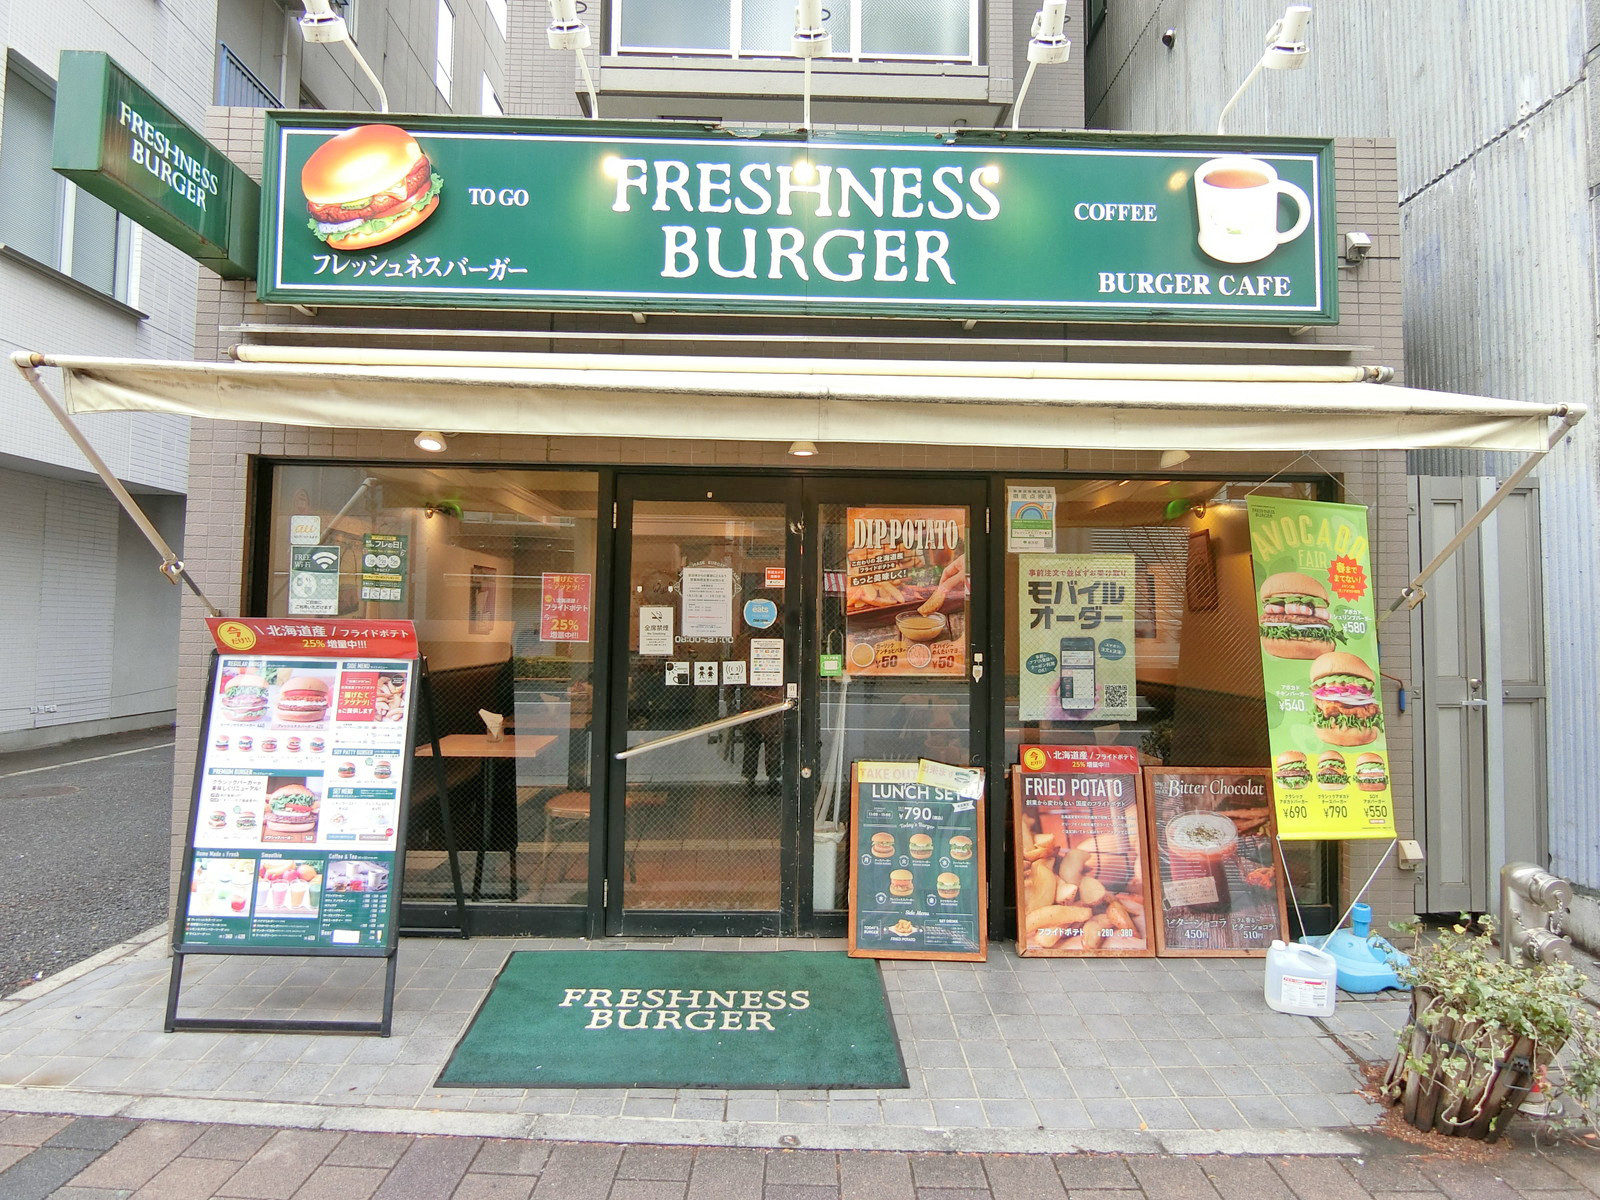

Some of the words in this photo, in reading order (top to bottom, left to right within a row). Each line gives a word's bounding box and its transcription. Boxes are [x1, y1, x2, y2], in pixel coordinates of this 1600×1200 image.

[119, 101, 219, 197] FRESHNESS
[131, 138, 208, 213] BURGER
[612, 158, 1001, 222] FRESHNESS
[468, 188, 495, 207] TO
[498, 188, 529, 208] GO
[1073, 202, 1158, 223] COFFEE
[660, 225, 956, 286] BURGER
[312, 253, 529, 282] フレッシュネスバーガー
[1098, 271, 1211, 297] BURGER
[1218, 274, 1292, 298] CAFE
[853, 518, 887, 549] DIP
[889, 519, 959, 550] POTATO
[1252, 515, 1367, 565] AVOCADO
[1298, 549, 1328, 569] FAIR
[1336, 562, 1358, 574] 春まで
[852, 570, 907, 585] もっと美味しく!
[1333, 574, 1362, 584] まてない!
[1028, 580, 1125, 605] モバイル
[544, 604, 589, 612] フライドポテト
[550, 619, 579, 631] 25%
[1030, 606, 1124, 630] オーダー
[227, 626, 241, 638] 今
[267, 624, 327, 638] 北海道産
[340, 628, 410, 638] フライドポテト
[1342, 621, 1366, 634] ¥580
[231, 637, 252, 645] だけ!!
[302, 639, 326, 649] 25%
[327, 639, 368, 649] 増量中!!!
[875, 655, 898, 669] ¥50
[932, 655, 955, 669] ¥50
[1278, 699, 1305, 712] ¥540
[1029, 751, 1039, 761] 今
[1053, 750, 1088, 760] 北海道産
[1095, 753, 1135, 761] フライドポテト
[860, 767, 891, 779] TAKE
[892, 768, 918, 780] OUT
[872, 784, 929, 800] LUNCH
[1025, 777, 1066, 796] FRIED
[1071, 778, 1123, 797] POTATO
[1168, 779, 1208, 797] Bitter
[1209, 778, 1265, 795] Chocolat
[898, 807, 932, 820] ¥790
[1283, 805, 1307, 818] ¥690
[1323, 805, 1348, 818] ¥790
[1363, 805, 1388, 818] ¥550
[1166, 917, 1227, 929] ビターショコラ
[1037, 928, 1085, 936] フライドポテト
[1184, 930, 1209, 939] 450円
[1243, 931, 1264, 939] 510円
[559, 988, 811, 1010] FRESHNESS
[585, 1009, 776, 1031] BURGER
